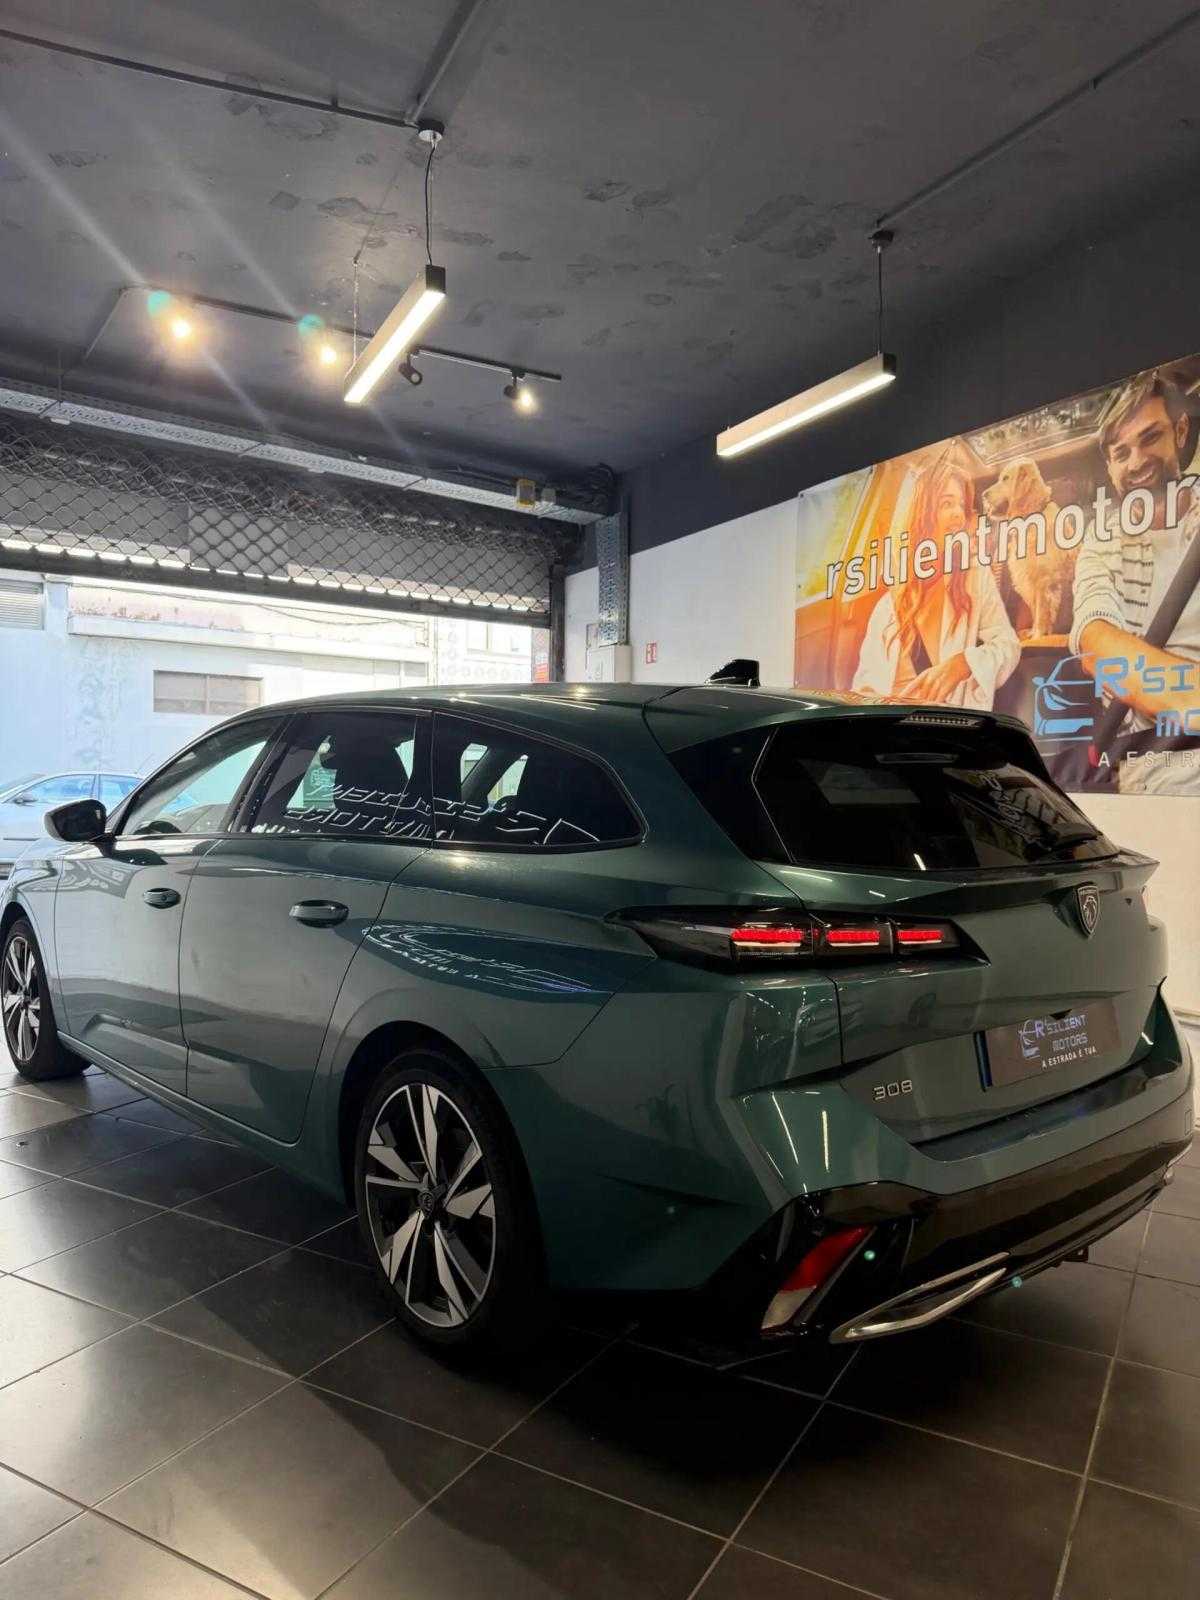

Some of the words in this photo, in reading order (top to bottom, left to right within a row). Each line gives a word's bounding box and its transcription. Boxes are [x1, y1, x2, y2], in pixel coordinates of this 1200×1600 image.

[1097, 751, 1111, 767] A
[1052, 1032, 1089, 1052] MOTORS
[1048, 1051, 1077, 1067] ESTRADA
[873, 1079, 913, 1101] 308
